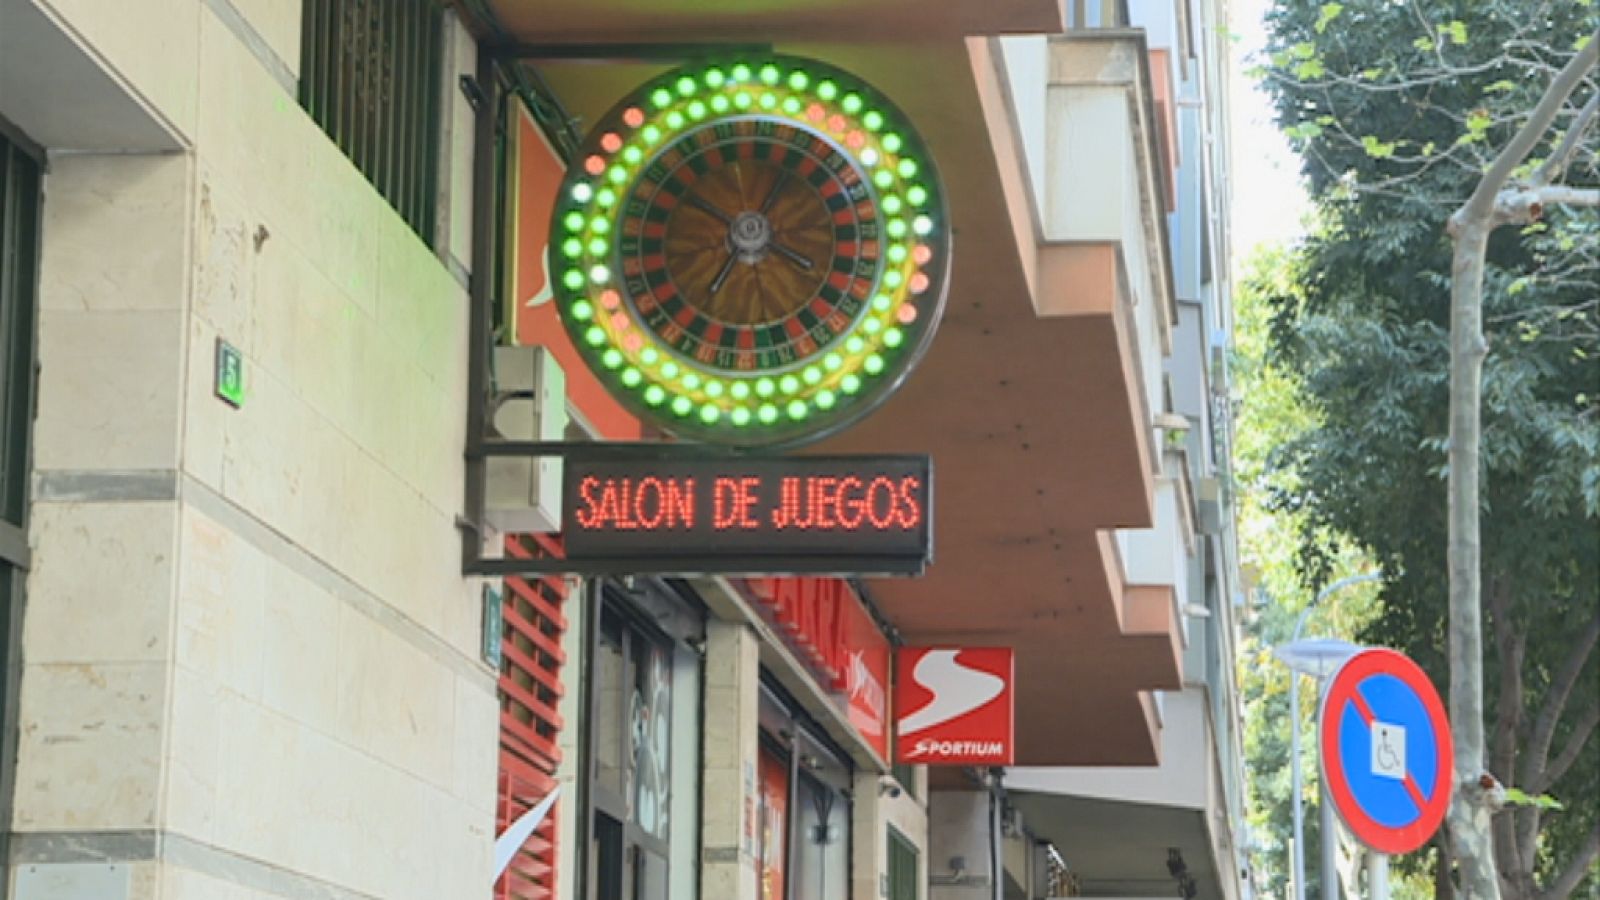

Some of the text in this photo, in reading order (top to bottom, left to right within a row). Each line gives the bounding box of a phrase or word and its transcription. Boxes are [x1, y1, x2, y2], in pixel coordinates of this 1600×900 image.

[576, 476, 921, 529] SALON DE JUEGOS
[905, 739, 1003, 757] SPORTIUM
